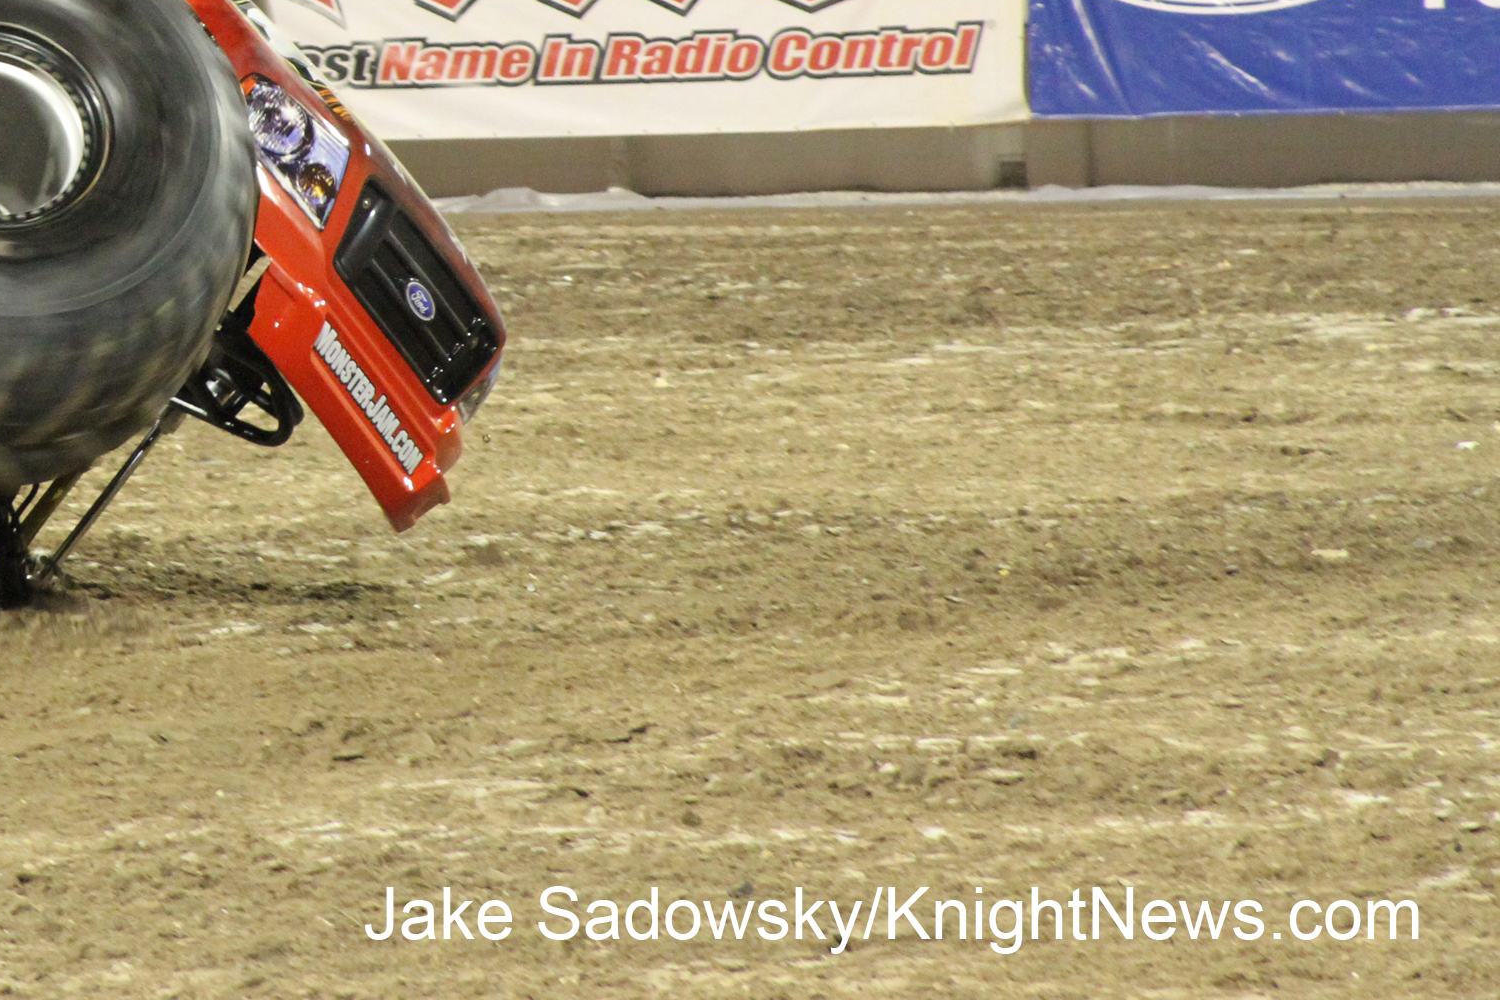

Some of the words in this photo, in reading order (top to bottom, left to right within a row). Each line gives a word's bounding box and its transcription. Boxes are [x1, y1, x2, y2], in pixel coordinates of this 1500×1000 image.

[375, 43, 532, 83] Name
[540, 40, 598, 79] In
[604, 36, 762, 76] Radio
[768, 27, 978, 74] Control
